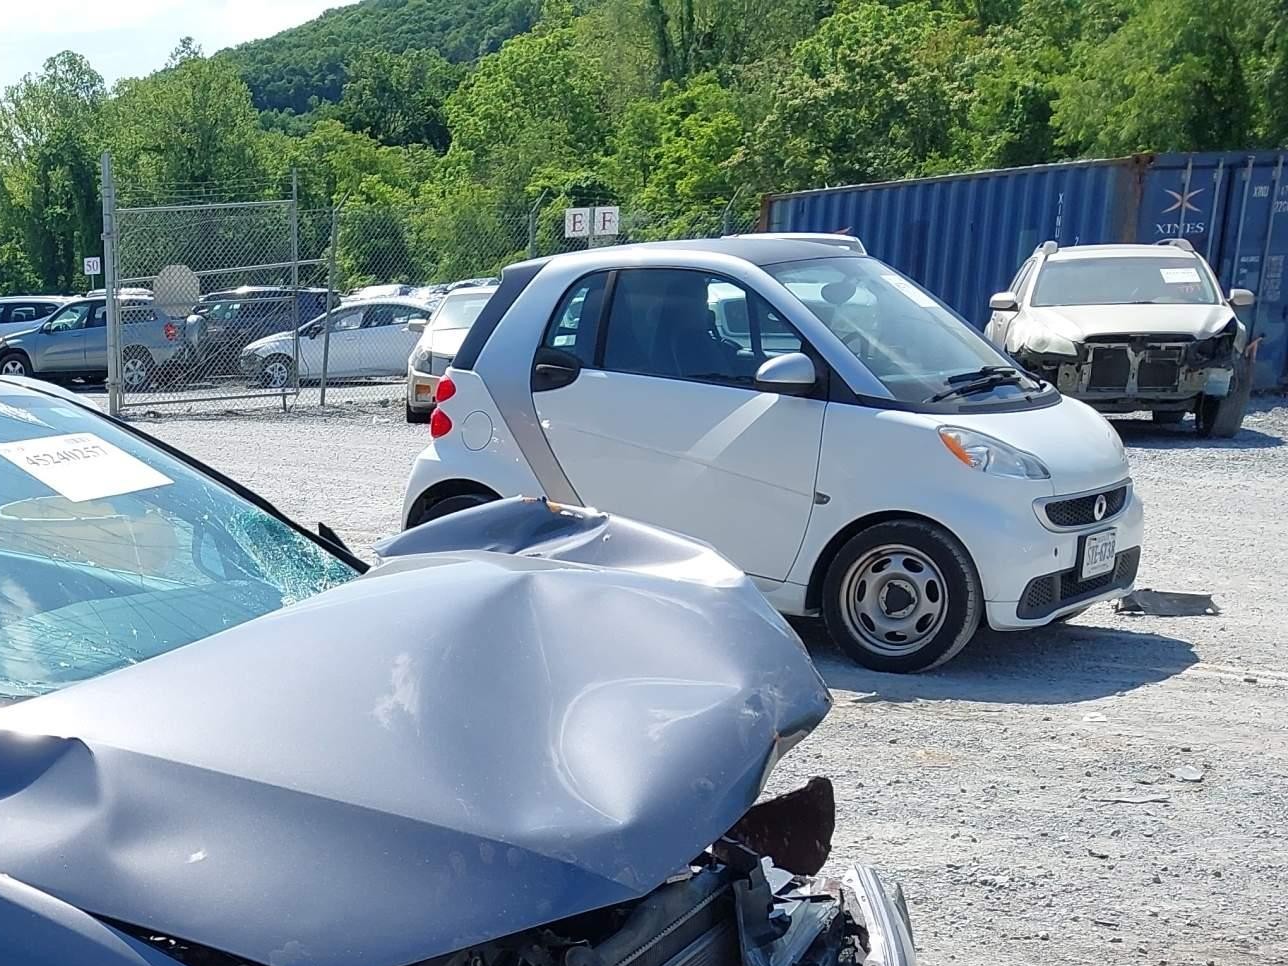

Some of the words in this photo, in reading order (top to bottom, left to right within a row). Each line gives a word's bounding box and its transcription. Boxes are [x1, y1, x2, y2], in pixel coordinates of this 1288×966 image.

[571, 213, 584, 232] E
[601, 211, 613, 231] F
[1154, 222, 1205, 234] XINES
[86, 260, 99, 272] 50
[25, 445, 108, 466] 45240257
